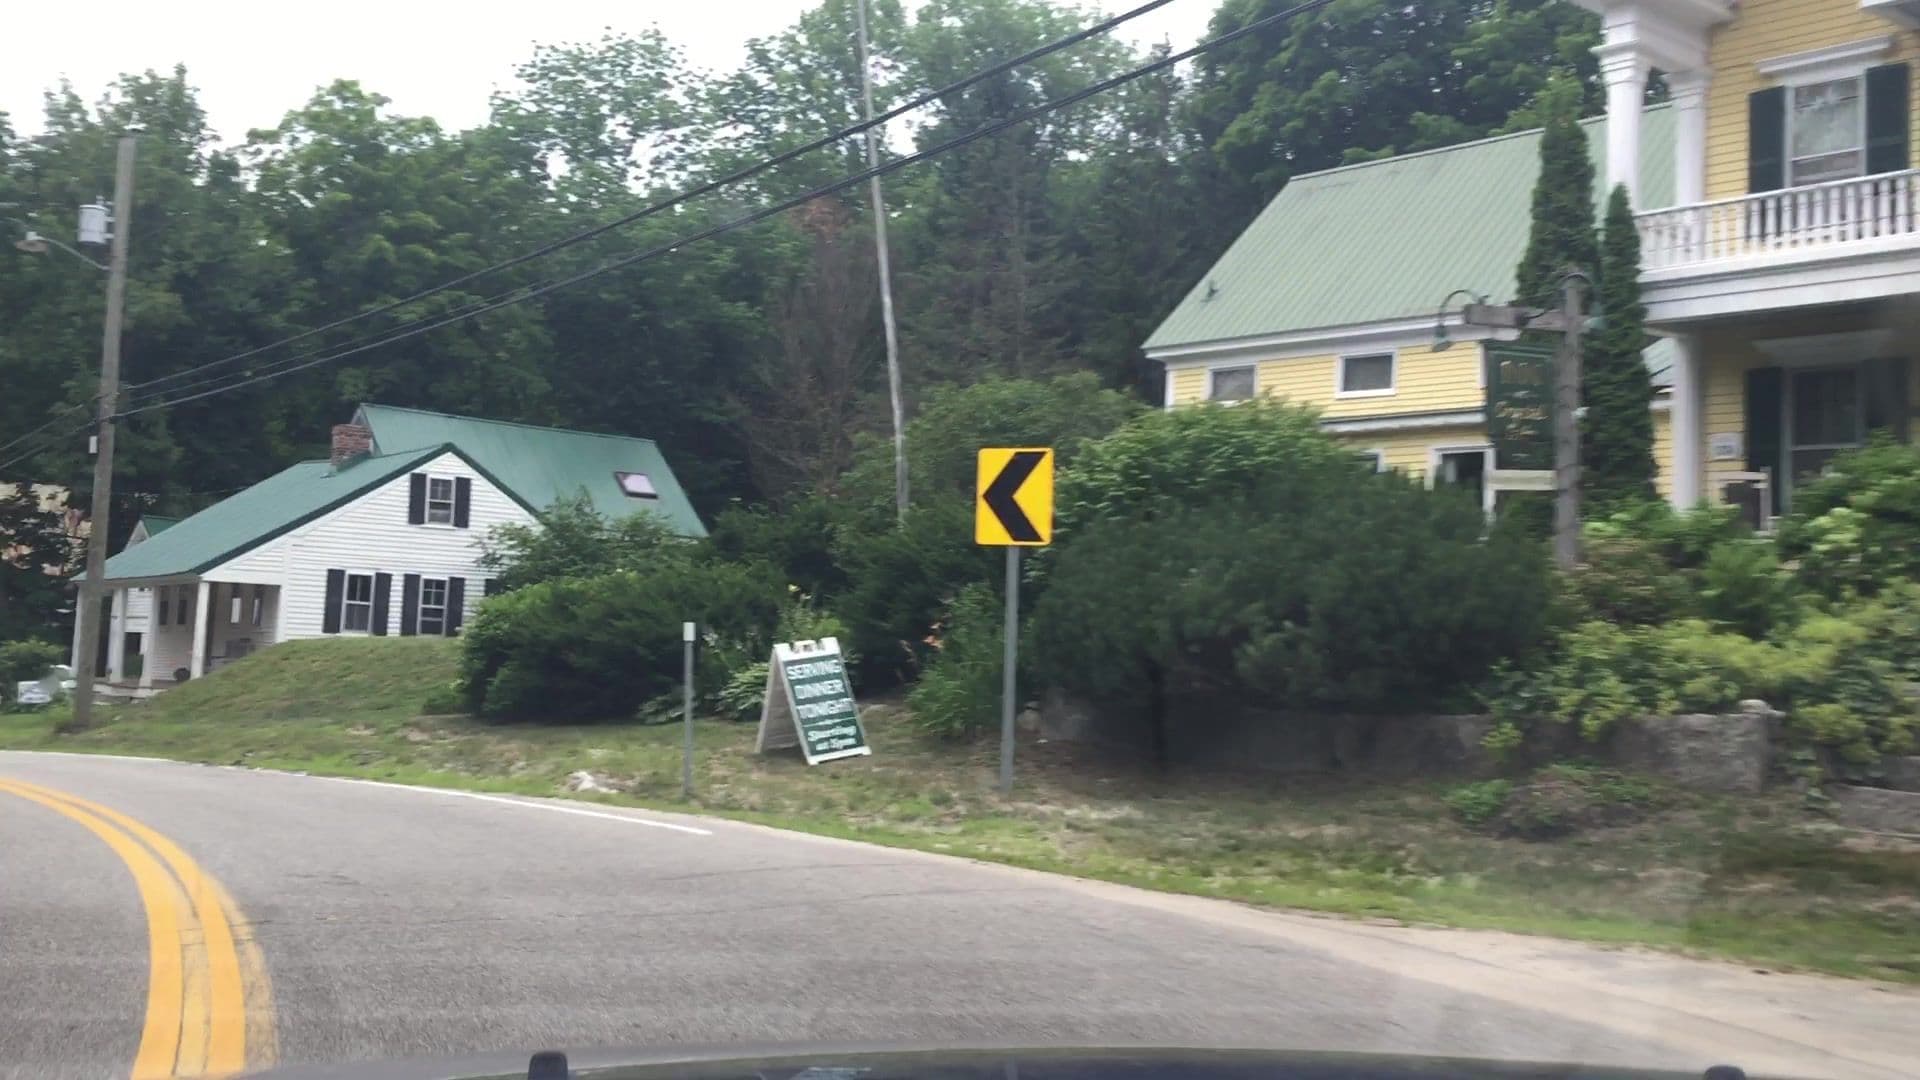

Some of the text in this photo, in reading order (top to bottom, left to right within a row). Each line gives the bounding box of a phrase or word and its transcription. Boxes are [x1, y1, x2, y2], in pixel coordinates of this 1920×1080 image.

[785, 660, 841, 680] SERVING
[794, 679, 845, 699] DINNER
[796, 697, 856, 719] TONIGHT
